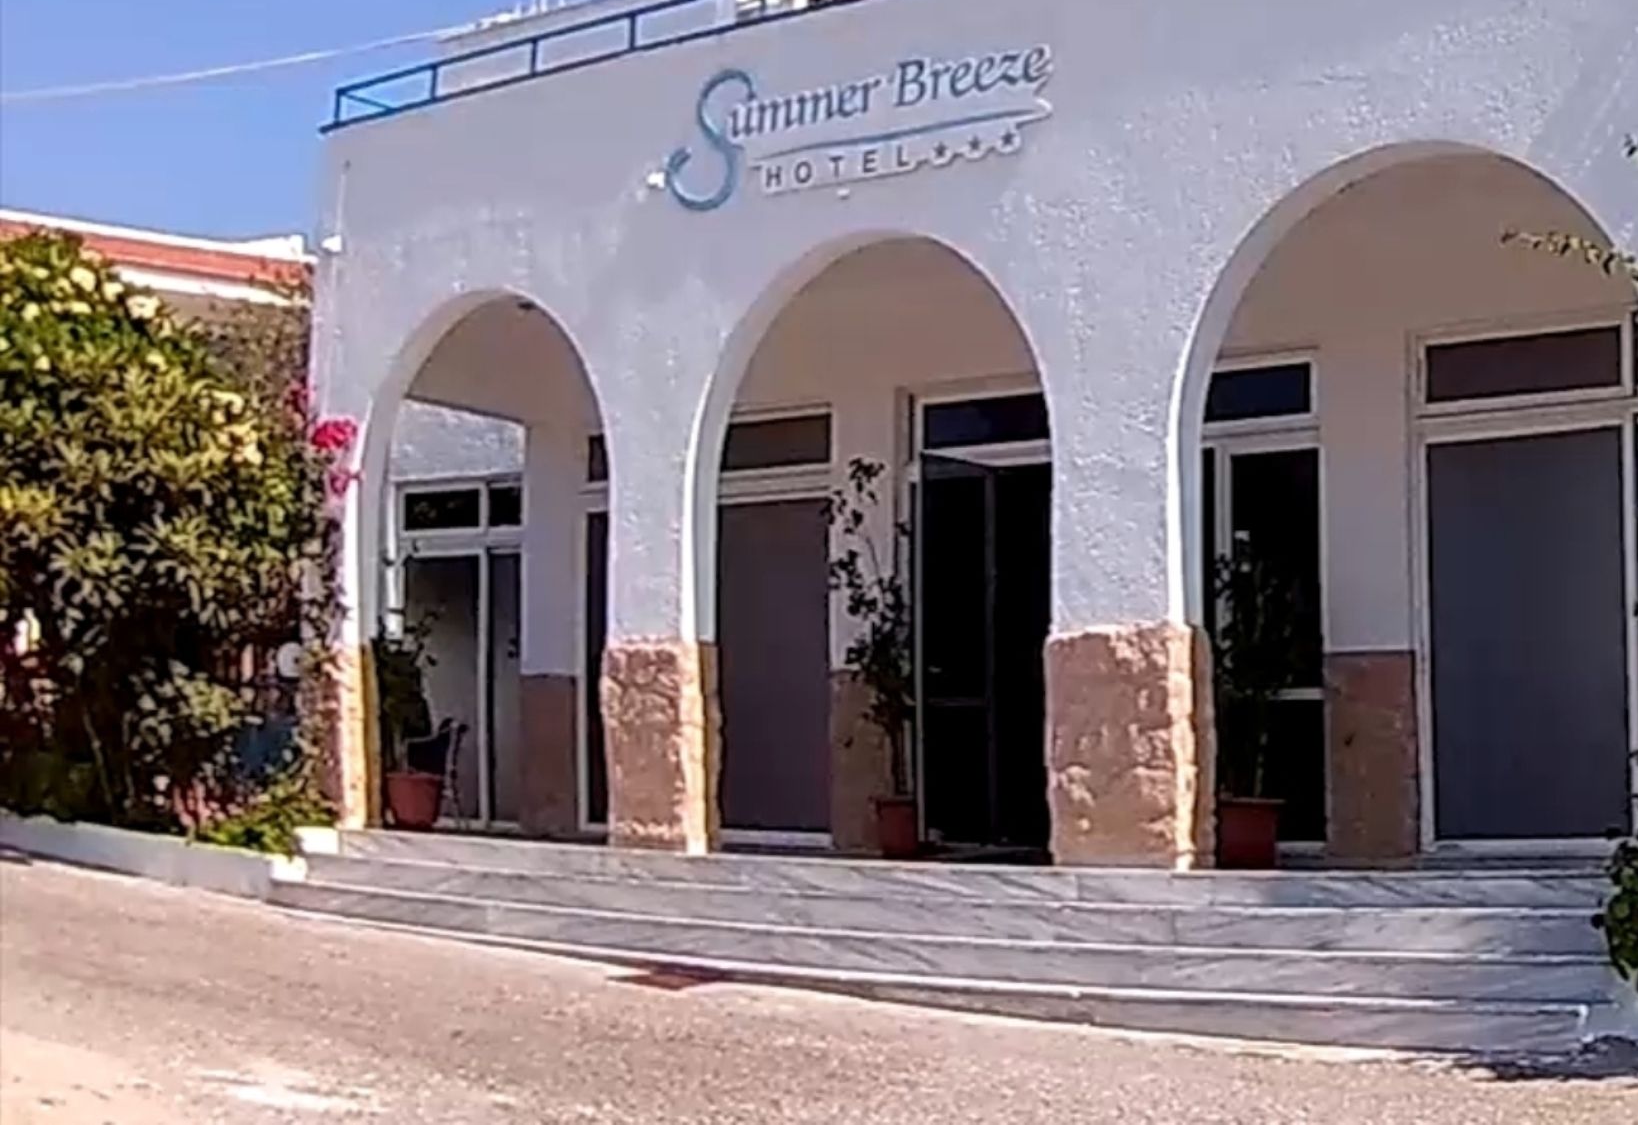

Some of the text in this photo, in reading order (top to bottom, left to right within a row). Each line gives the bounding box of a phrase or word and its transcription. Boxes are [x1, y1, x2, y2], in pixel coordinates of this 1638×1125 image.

[664, 43, 1051, 212] Summer Breeze
[764, 145, 913, 189] HOTEL
